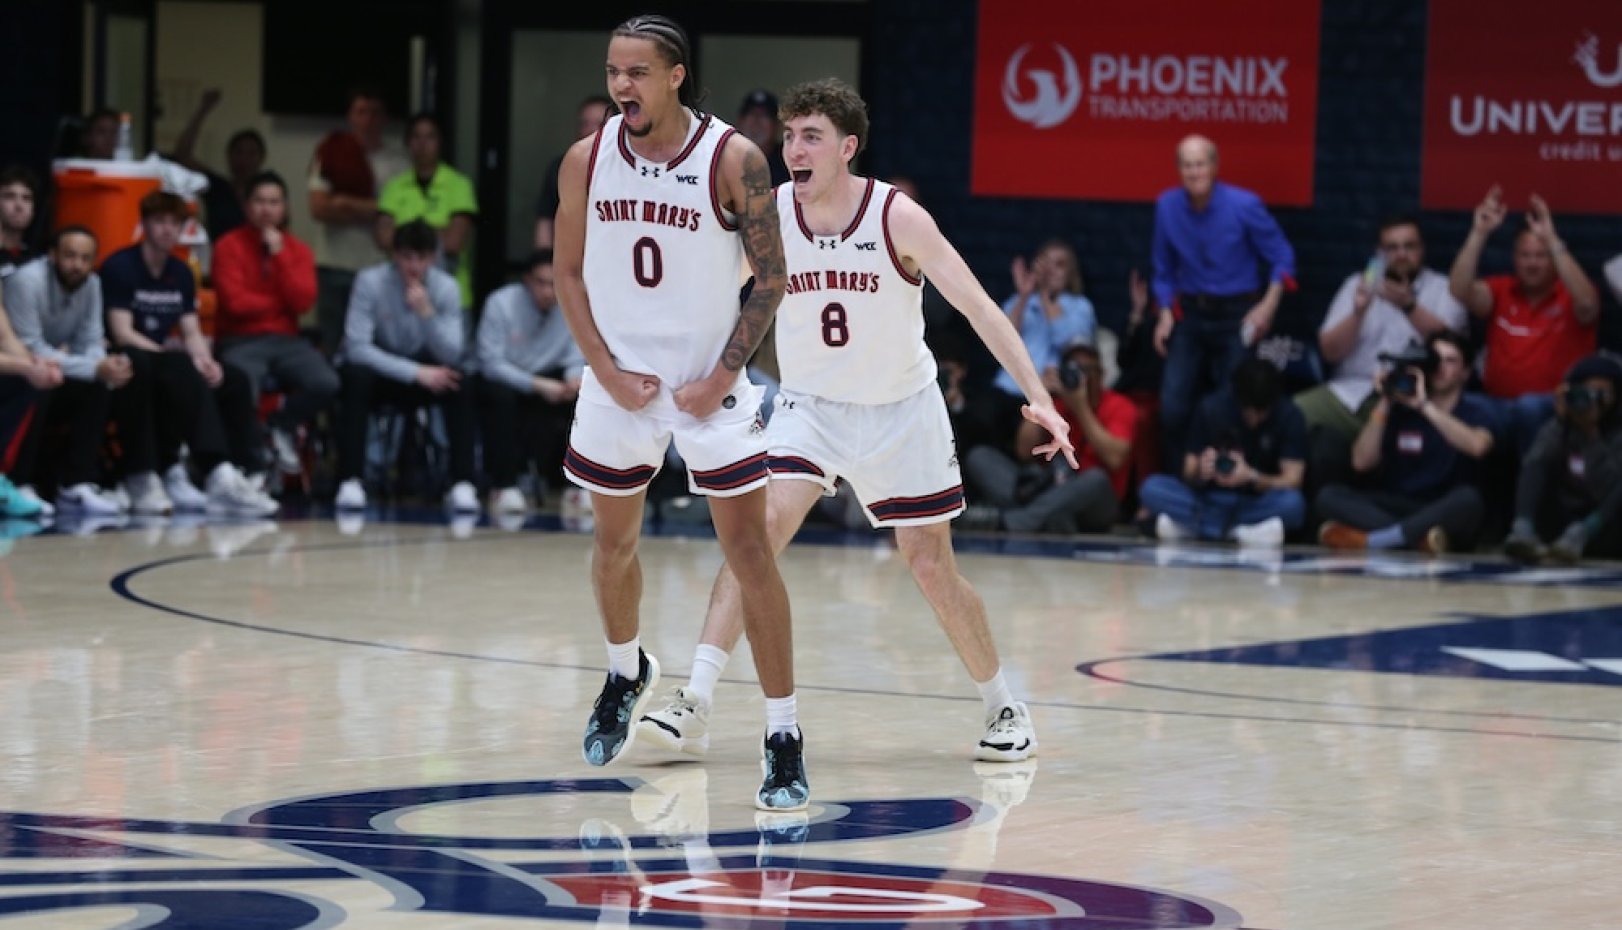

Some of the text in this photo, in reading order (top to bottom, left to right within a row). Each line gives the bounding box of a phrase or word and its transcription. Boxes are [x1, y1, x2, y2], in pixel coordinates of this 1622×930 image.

[1090, 53, 1288, 96] PHOENIX
[1088, 95, 1288, 123] TRANSPORTATION
[1539, 140, 1601, 161] credit
[595, 199, 701, 232] SAINT MARY'S
[633, 236, 663, 288] 0
[825, 270, 880, 293] MARY'S
[821, 302, 849, 347] 8
